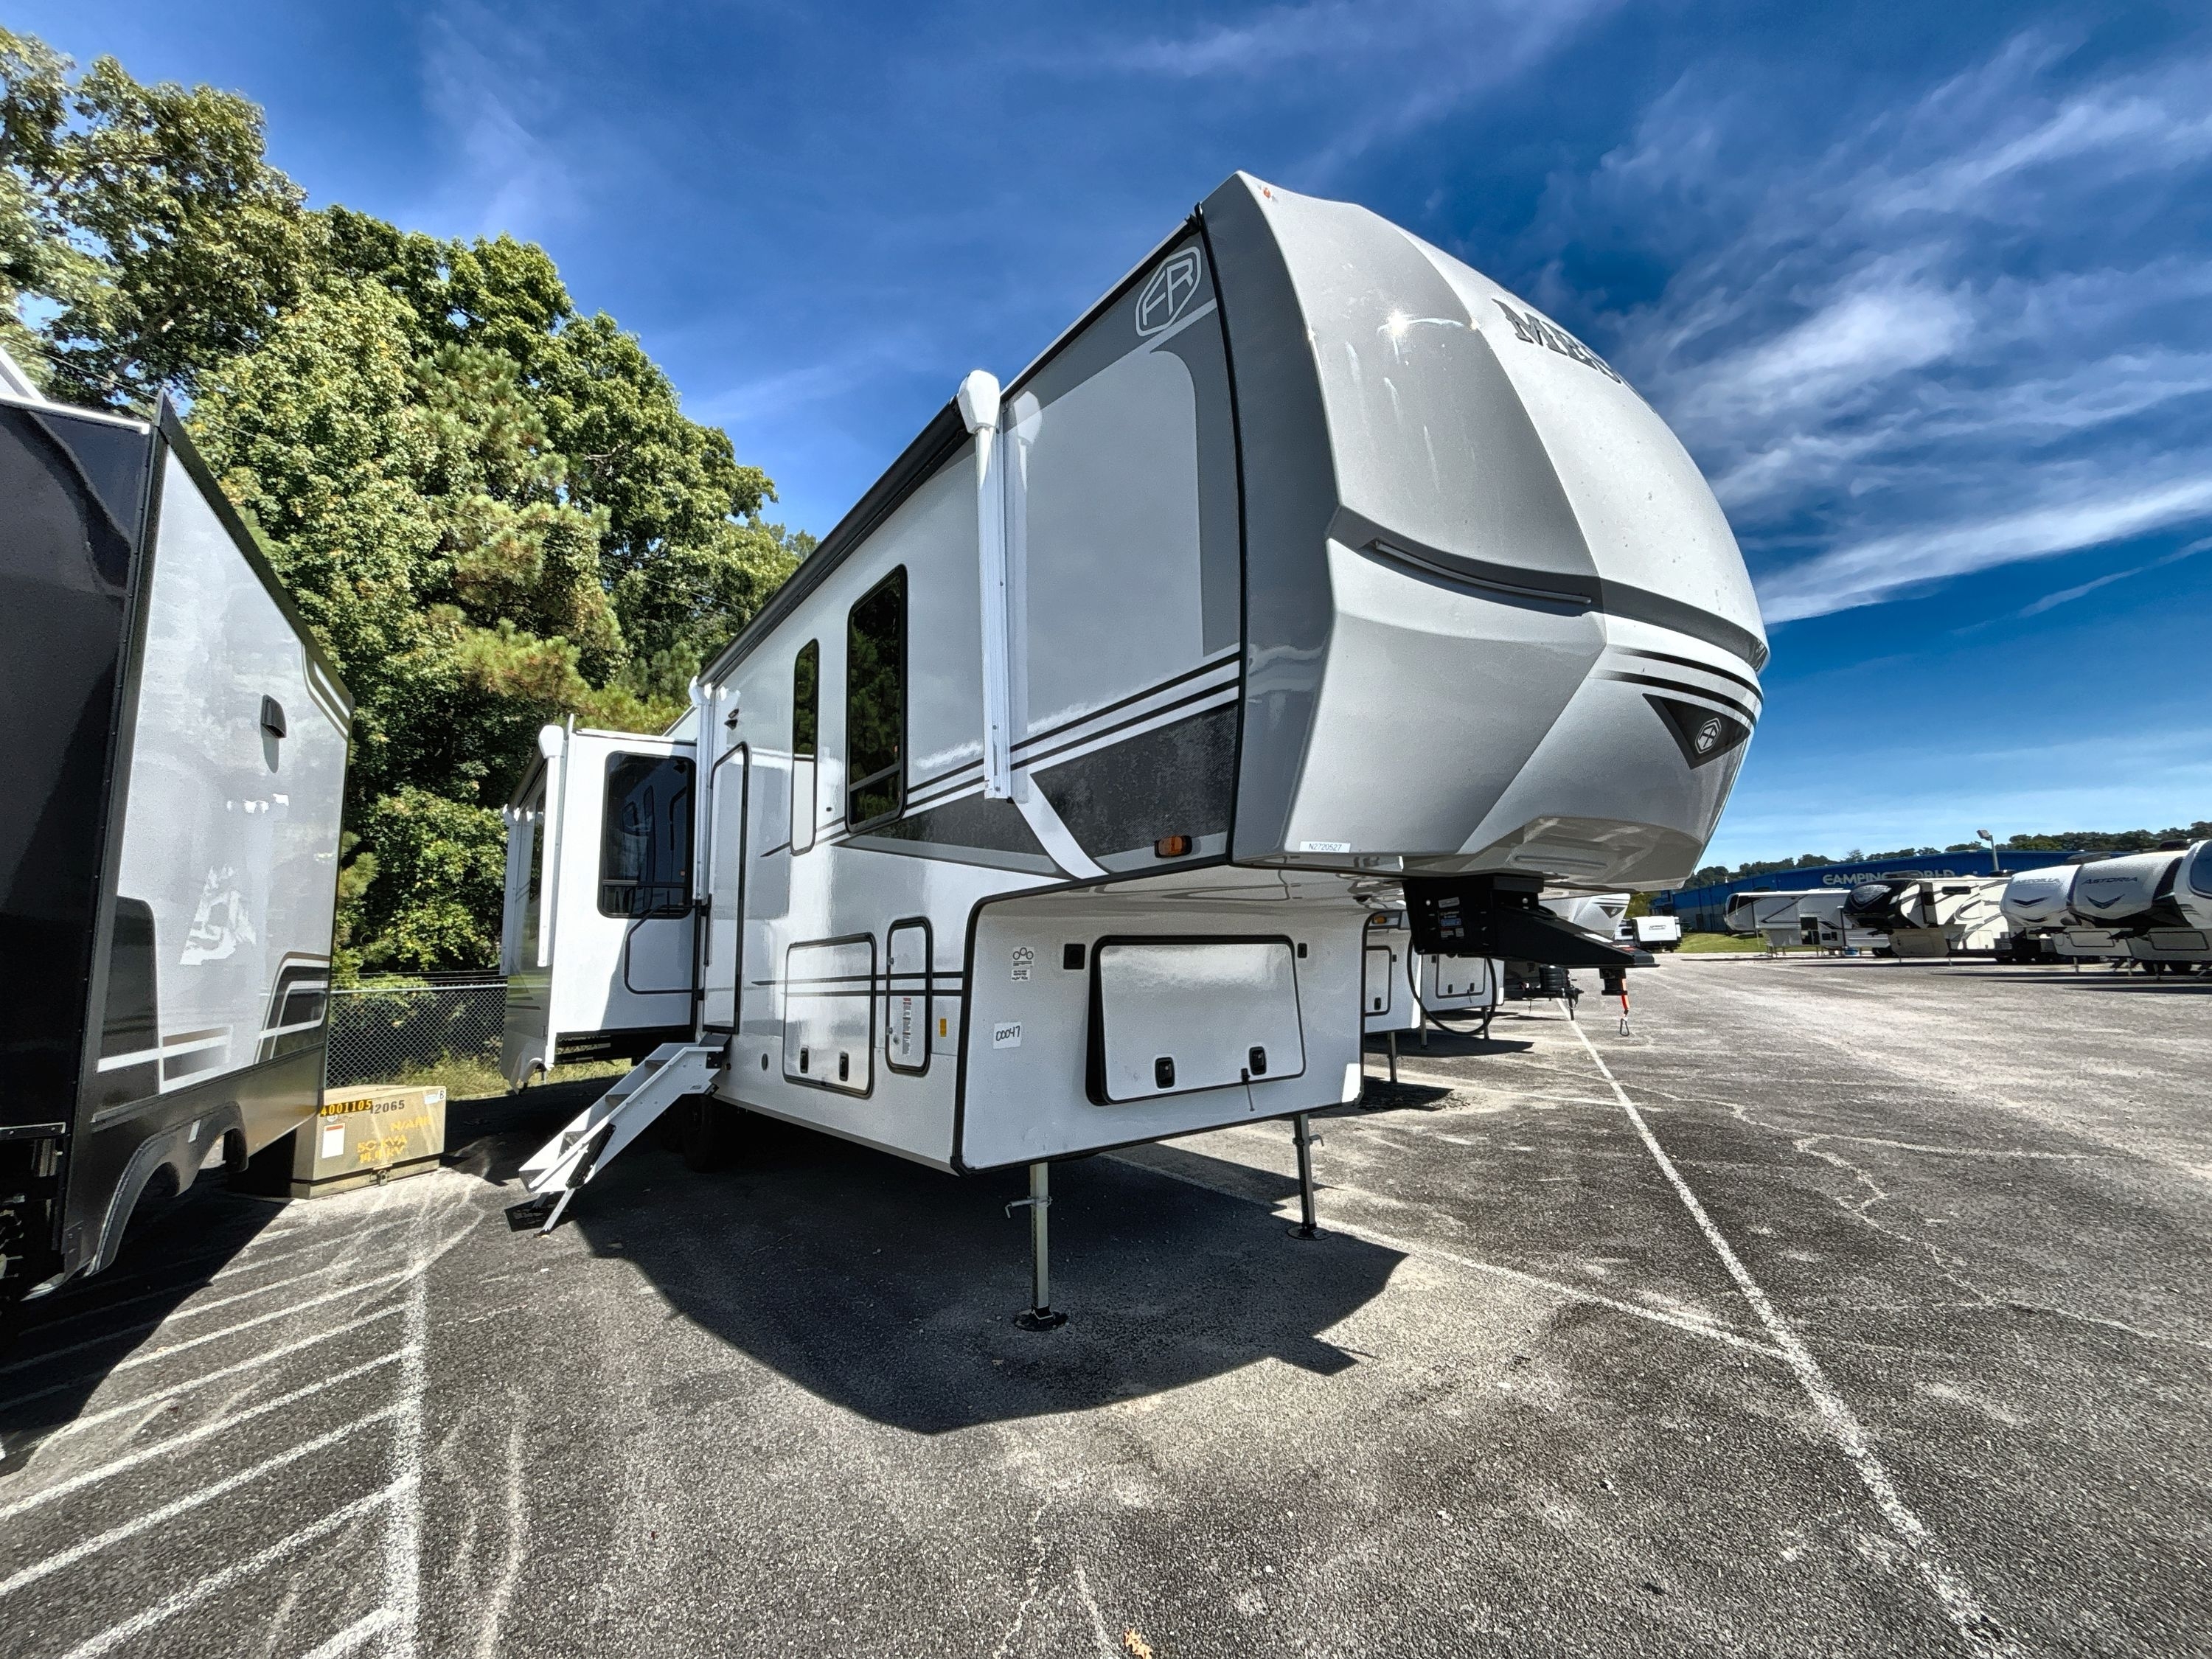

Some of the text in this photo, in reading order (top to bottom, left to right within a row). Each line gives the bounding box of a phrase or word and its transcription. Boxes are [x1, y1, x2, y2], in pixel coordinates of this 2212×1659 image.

[1491, 297, 1644, 403] MES
[1308, 843, 1342, 852] N2720527
[2082, 876, 2138, 885] ASTORIA
[995, 1026, 1020, 1041] 00047
[320, 1099, 372, 1116] 4001105
